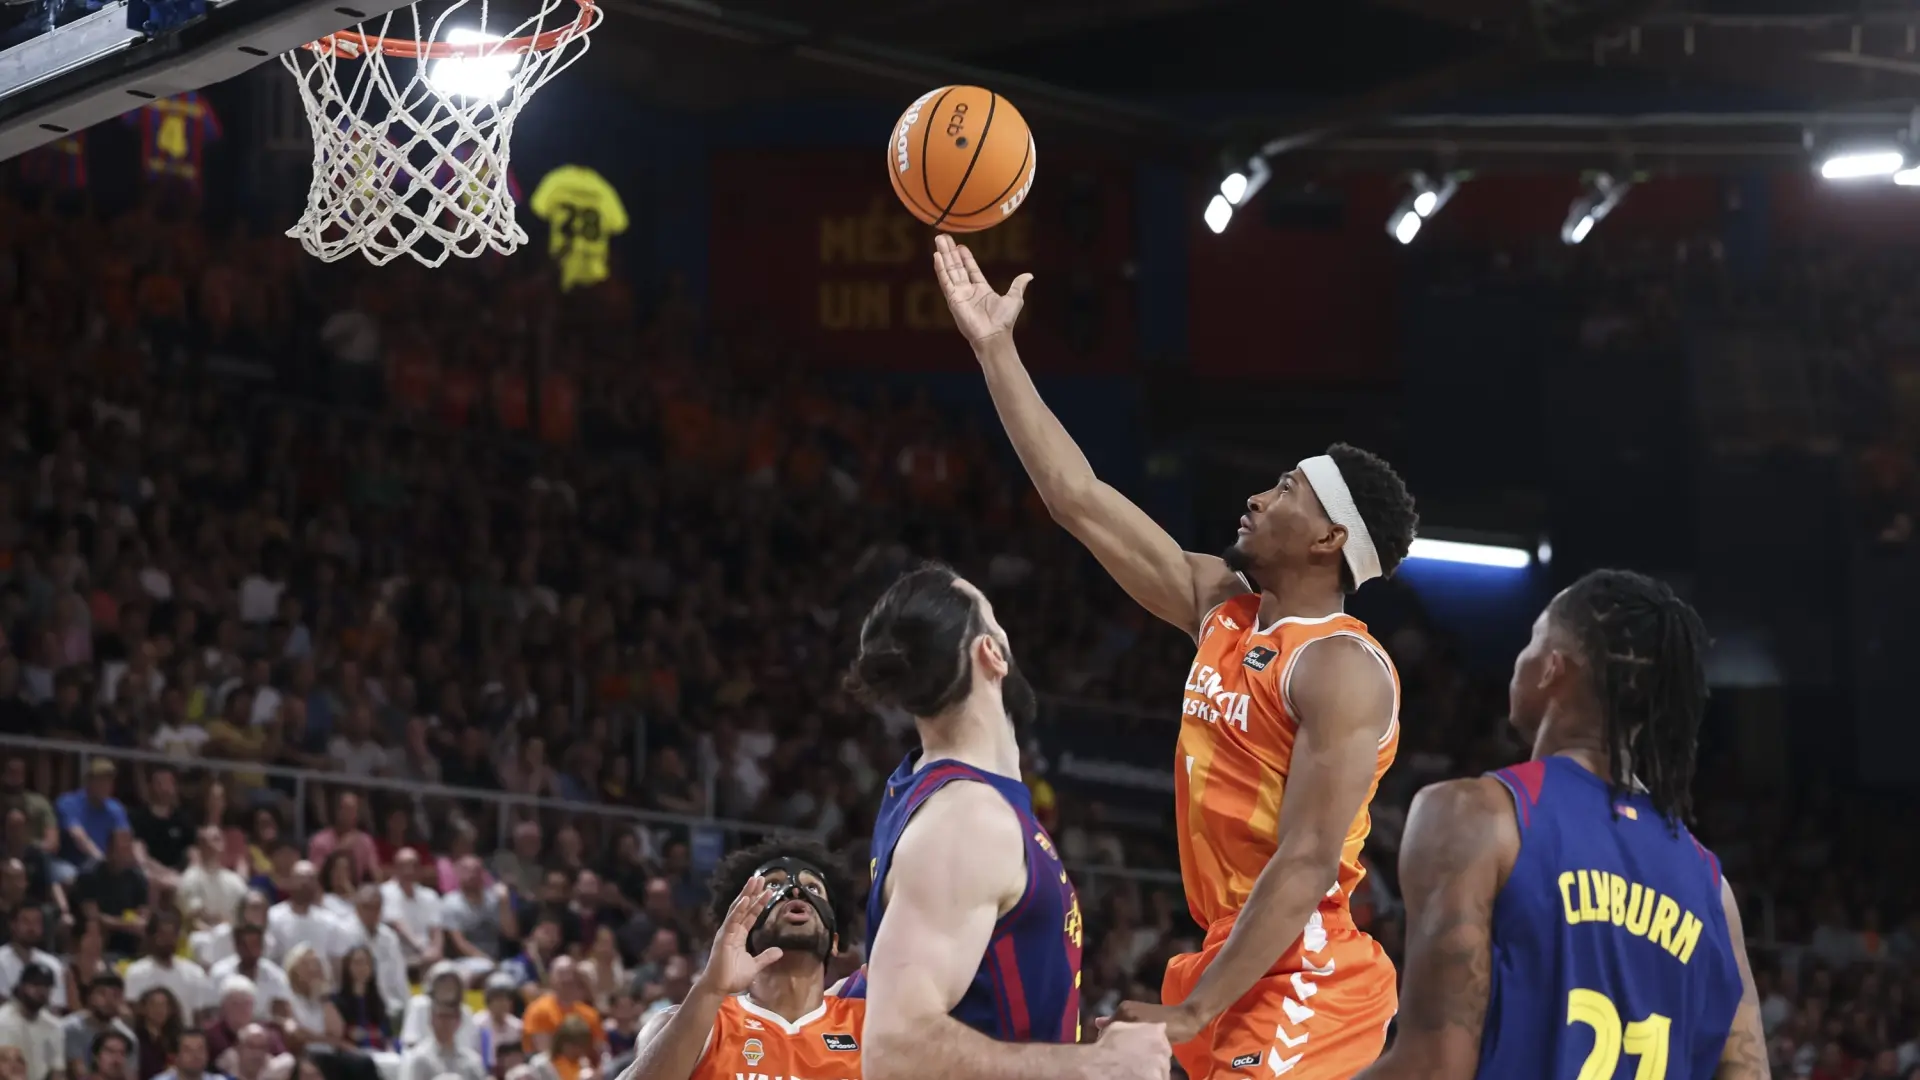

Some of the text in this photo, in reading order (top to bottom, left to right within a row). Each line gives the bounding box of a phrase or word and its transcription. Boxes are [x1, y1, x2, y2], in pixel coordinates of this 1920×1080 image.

[946, 102, 969, 137] acb
[819, 281, 890, 331] UN
[1558, 869, 1704, 965] CLYBURN
[1567, 987, 1672, 1080] 21
[1233, 1056, 1254, 1066] acb
